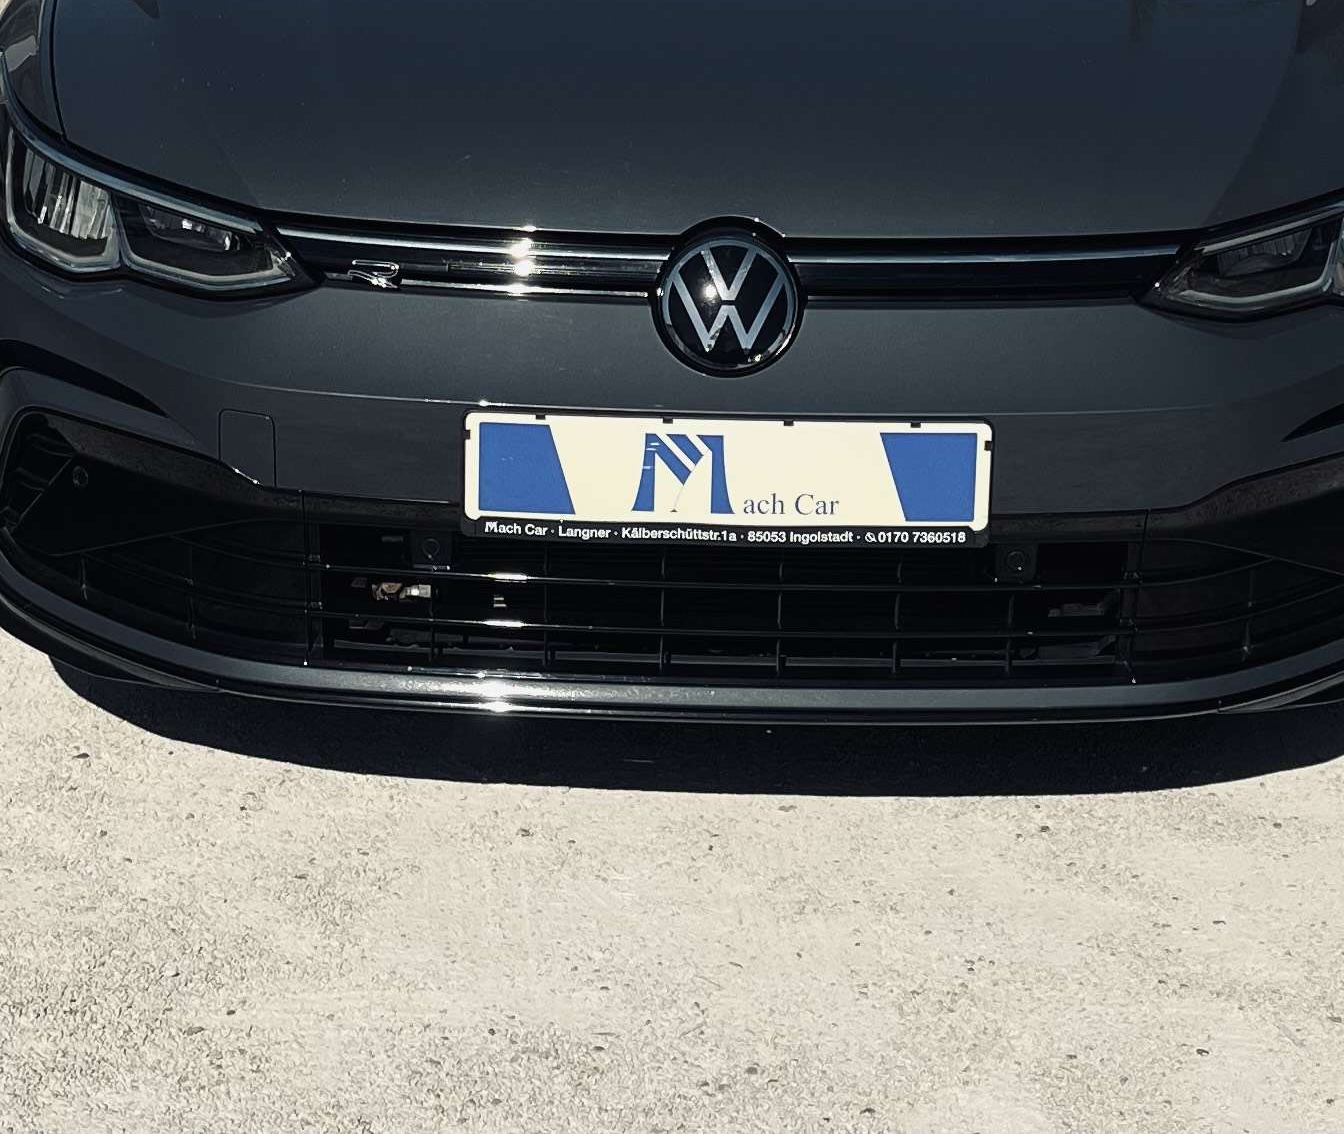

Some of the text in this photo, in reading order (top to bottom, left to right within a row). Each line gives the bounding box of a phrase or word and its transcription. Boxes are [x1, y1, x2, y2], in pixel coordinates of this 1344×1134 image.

[795, 492, 840, 516] Car
[484, 521, 967, 544] Mach Car Langner Kälberschüttstr.1a 85053 Ingolstadt 0170 7360518
